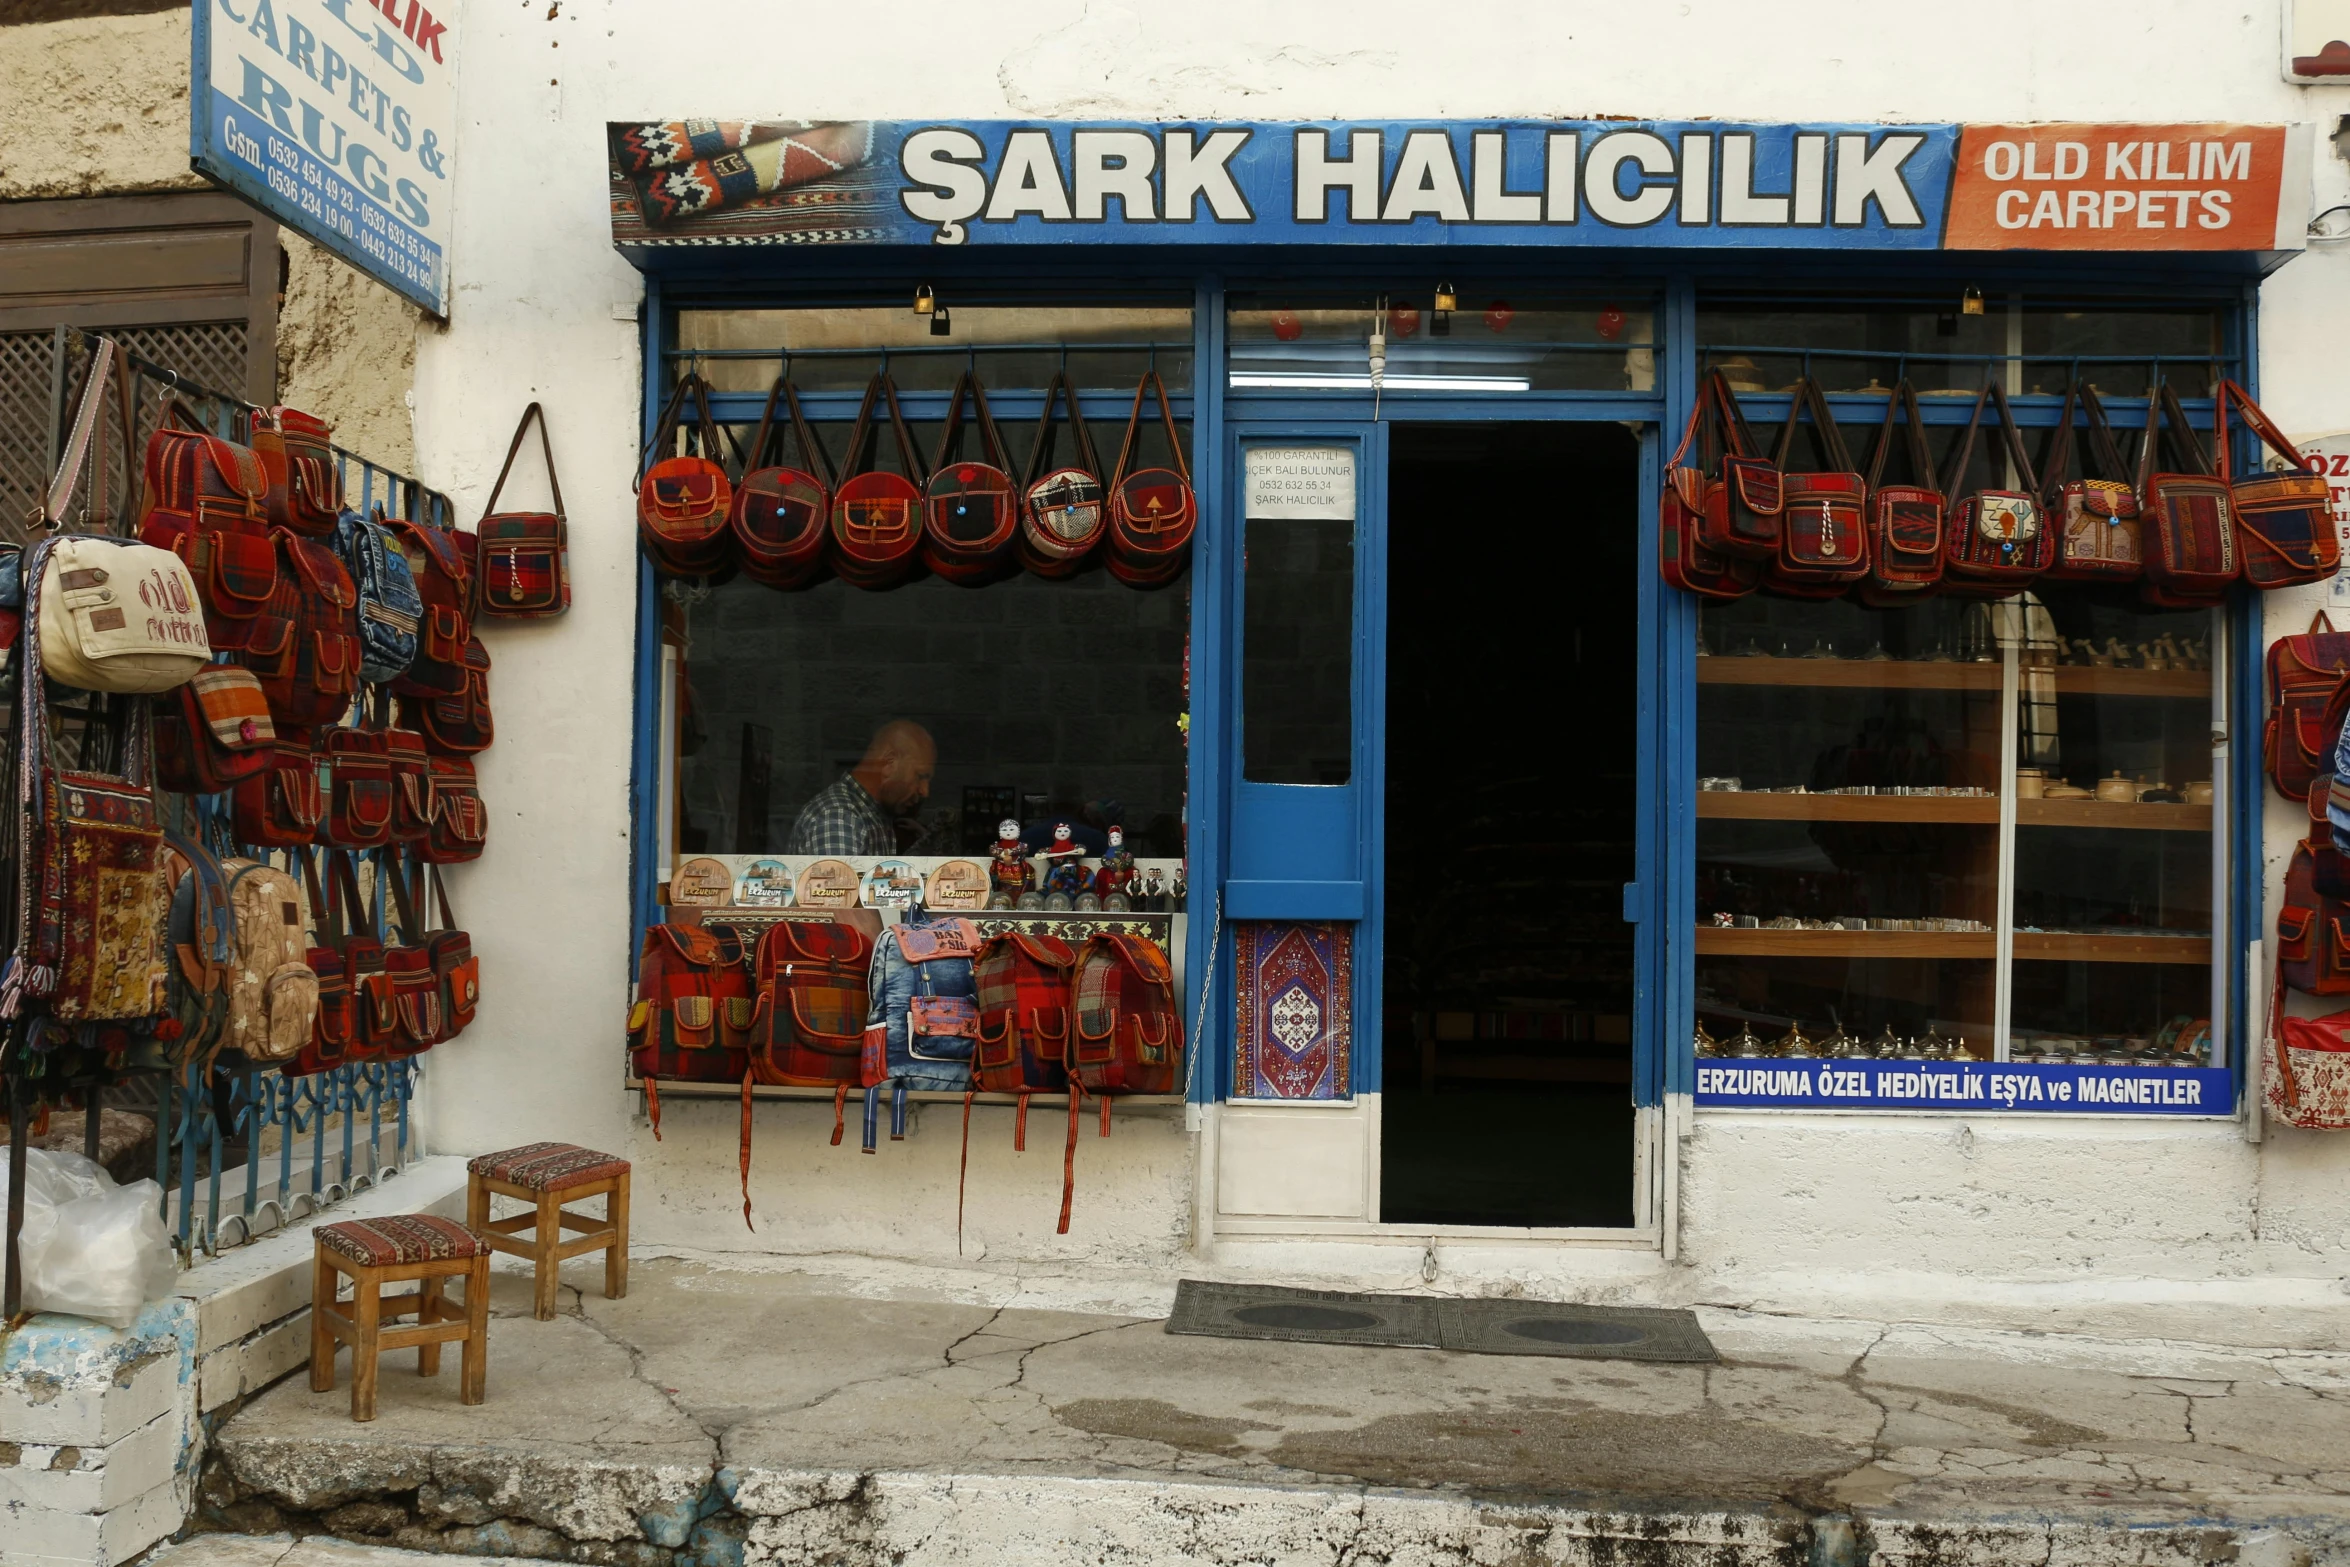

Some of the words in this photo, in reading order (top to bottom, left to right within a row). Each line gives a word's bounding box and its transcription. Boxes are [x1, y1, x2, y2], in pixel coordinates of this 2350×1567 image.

[368, 0, 447, 65] LIK
[238, 54, 430, 228] RUGS
[418, 128, 446, 179] &
[1984, 141, 2089, 181] OLD
[2104, 142, 2252, 181] KILIM
[224, 115, 265, 172] Gsm.
[268, 136, 298, 174] 0532
[301, 160, 322, 190] 454
[325, 177, 338, 201] 49
[340, 187, 353, 212] 23
[361, 203, 385, 235] 0532
[388, 221, 405, 249] 632
[407, 234, 418, 257] 55
[420, 244, 431, 267] 34
[901, 130, 1254, 246] ŞARK
[1296, 131, 1924, 225] HALICILIK
[1995, 190, 2232, 229] CARPETS
[268, 166, 298, 202] 0536
[301, 187, 321, 218] 234
[325, 204, 337, 228] 19
[340, 215, 353, 238] 00
[361, 229, 385, 261] 0442
[387, 247, 405, 273] 213
[407, 260, 418, 283] 24
[420, 269, 430, 290] 99
[1254, 451, 1281, 460] %100
[1275, 466, 1298, 475] BALI
[1301, 466, 1351, 476] BULUNUR
[1259, 481, 1283, 490] 0532
[1285, 481, 1303, 490] 632
[1305, 481, 1318, 490] 55
[1320, 481, 1332, 490] 34
[1255, 495, 1284, 506] ŞARK
[1286, 496, 1335, 505] HALICILIK
[685, 888, 719, 897] ERZURUM
[748, 888, 782, 897] ERZURUM
[811, 889, 846, 898] ERZURUM
[875, 889, 910, 898] ERZURUM
[941, 890, 976, 898] ERZURUM
[933, 930, 964, 940] BAN
[1697, 1068, 1812, 1096] ERZURUMA
[1818, 1064, 1871, 1097] ÖZEL
[1877, 1065, 1985, 1100] HEDİYELİK
[1990, 1074, 2043, 1107] EŞYA
[2047, 1081, 2072, 1101] ve
[2077, 1076, 2201, 1105] MAGNETLER
